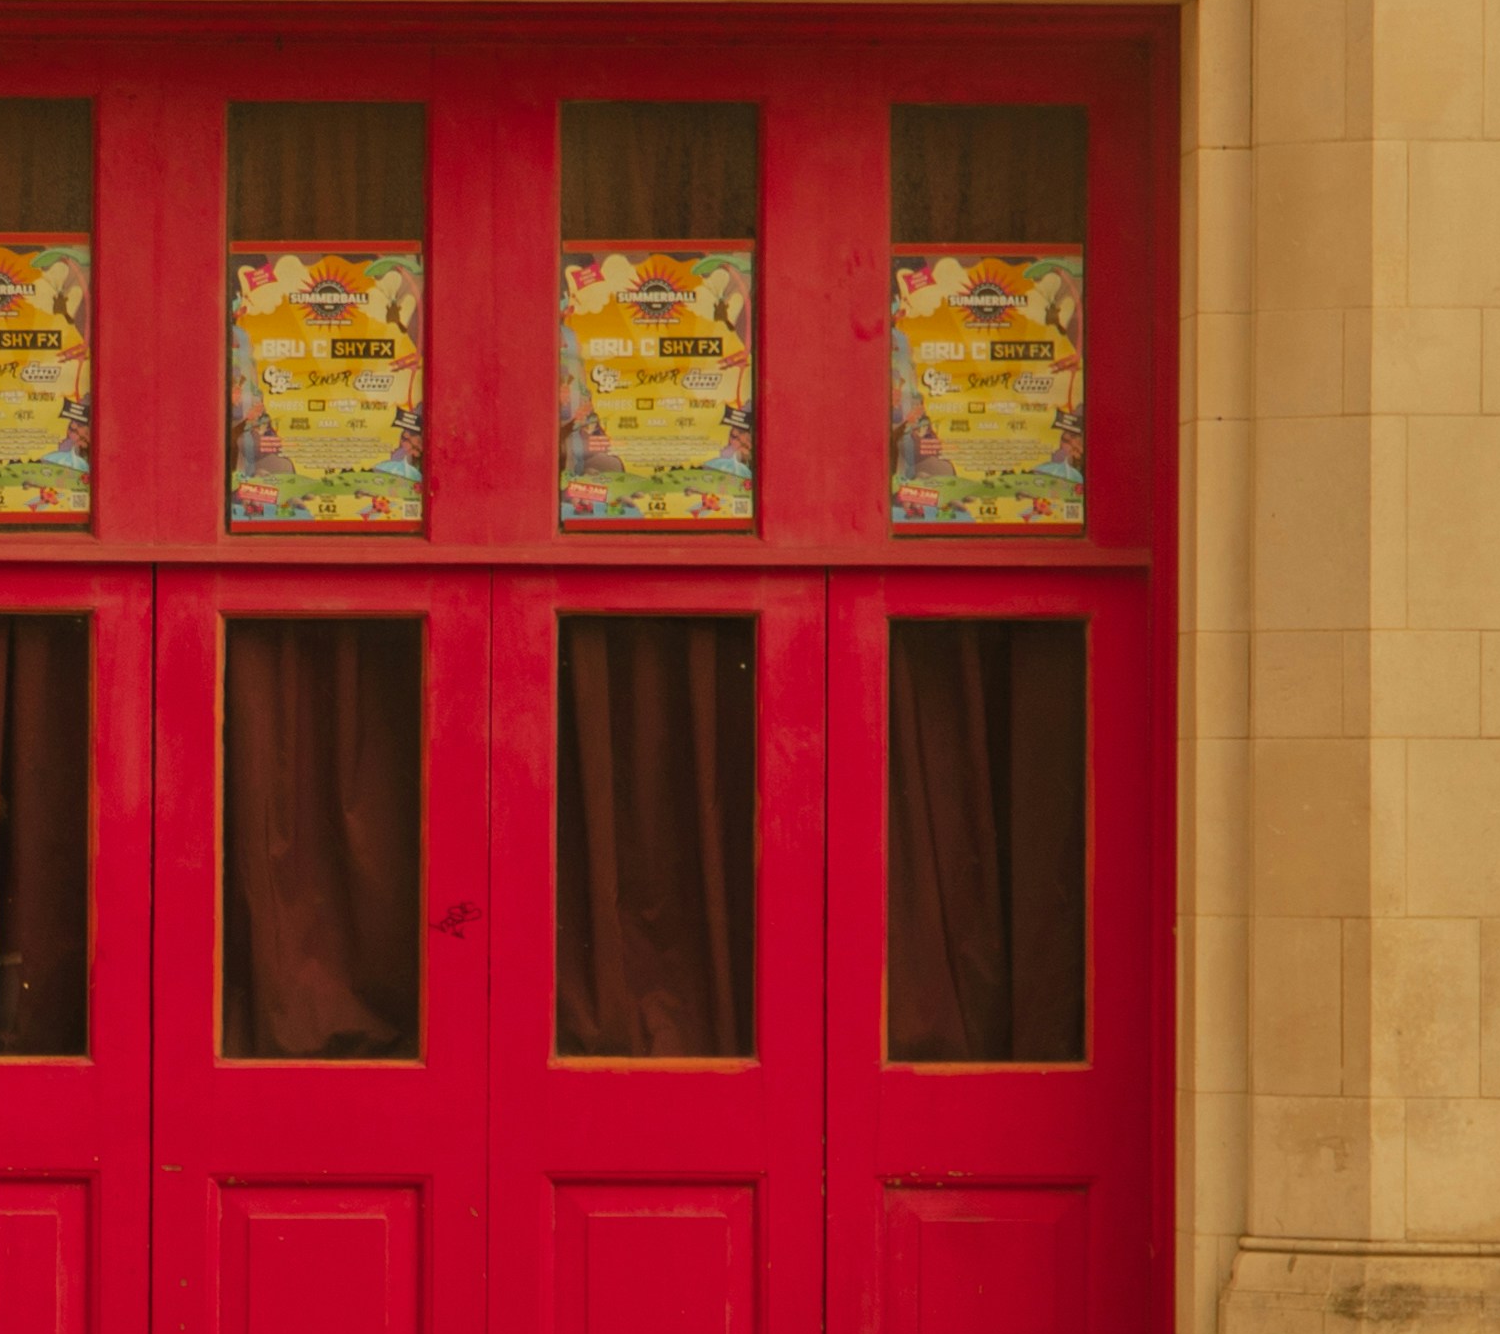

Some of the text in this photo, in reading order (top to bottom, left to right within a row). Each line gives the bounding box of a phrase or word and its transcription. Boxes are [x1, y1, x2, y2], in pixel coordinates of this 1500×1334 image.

[290, 293, 368, 303] SUMMERBALL
[617, 292, 695, 302] SUMMERBALL
[949, 296, 1027, 307] SUMMERBALL
[1, 333, 33, 347] SHY
[37, 333, 59, 347] FX
[262, 339, 392, 358] BRU C SHY FX
[590, 338, 720, 357] BRU C SHY FX
[921, 342, 1051, 361] BRU C SHY FX
[318, 505, 337, 514] £42
[648, 502, 667, 511] £42
